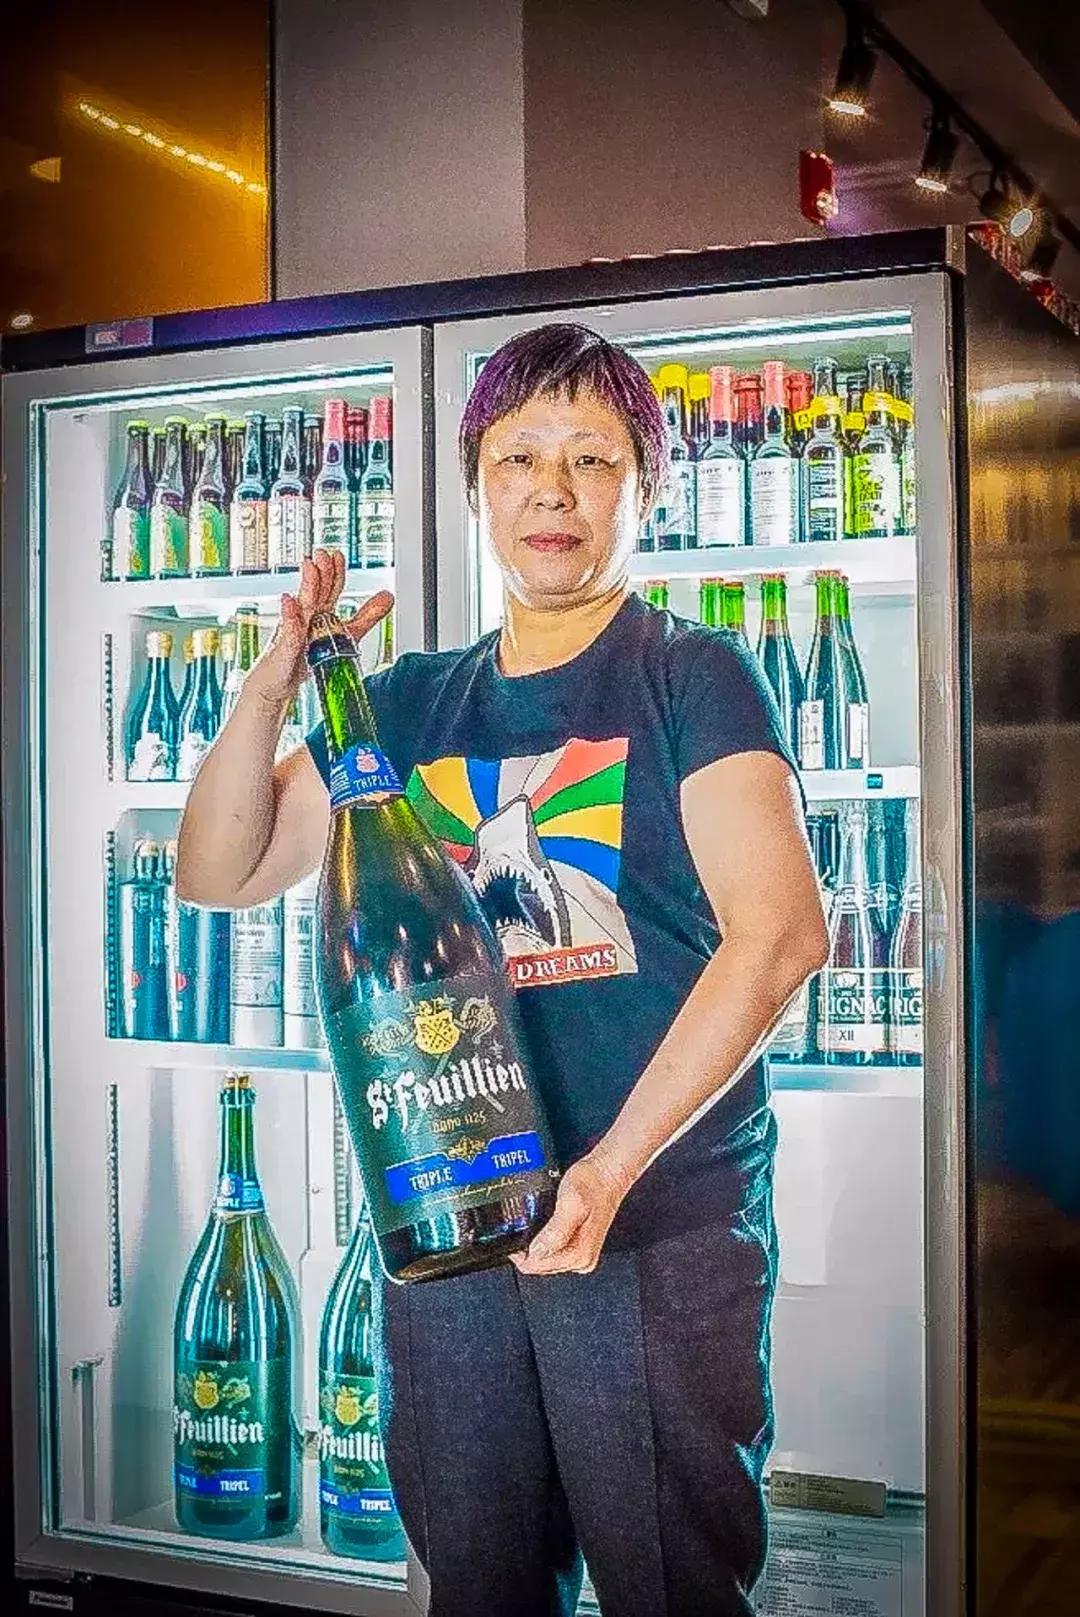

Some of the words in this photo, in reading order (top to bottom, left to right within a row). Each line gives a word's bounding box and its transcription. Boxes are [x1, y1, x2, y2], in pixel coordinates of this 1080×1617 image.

[515, 949, 616, 981] DREAMS
[464, 1110, 486, 1125] 1125
[409, 1165, 454, 1192] TRIPLE
[492, 1149, 532, 1169] TRIPEL
